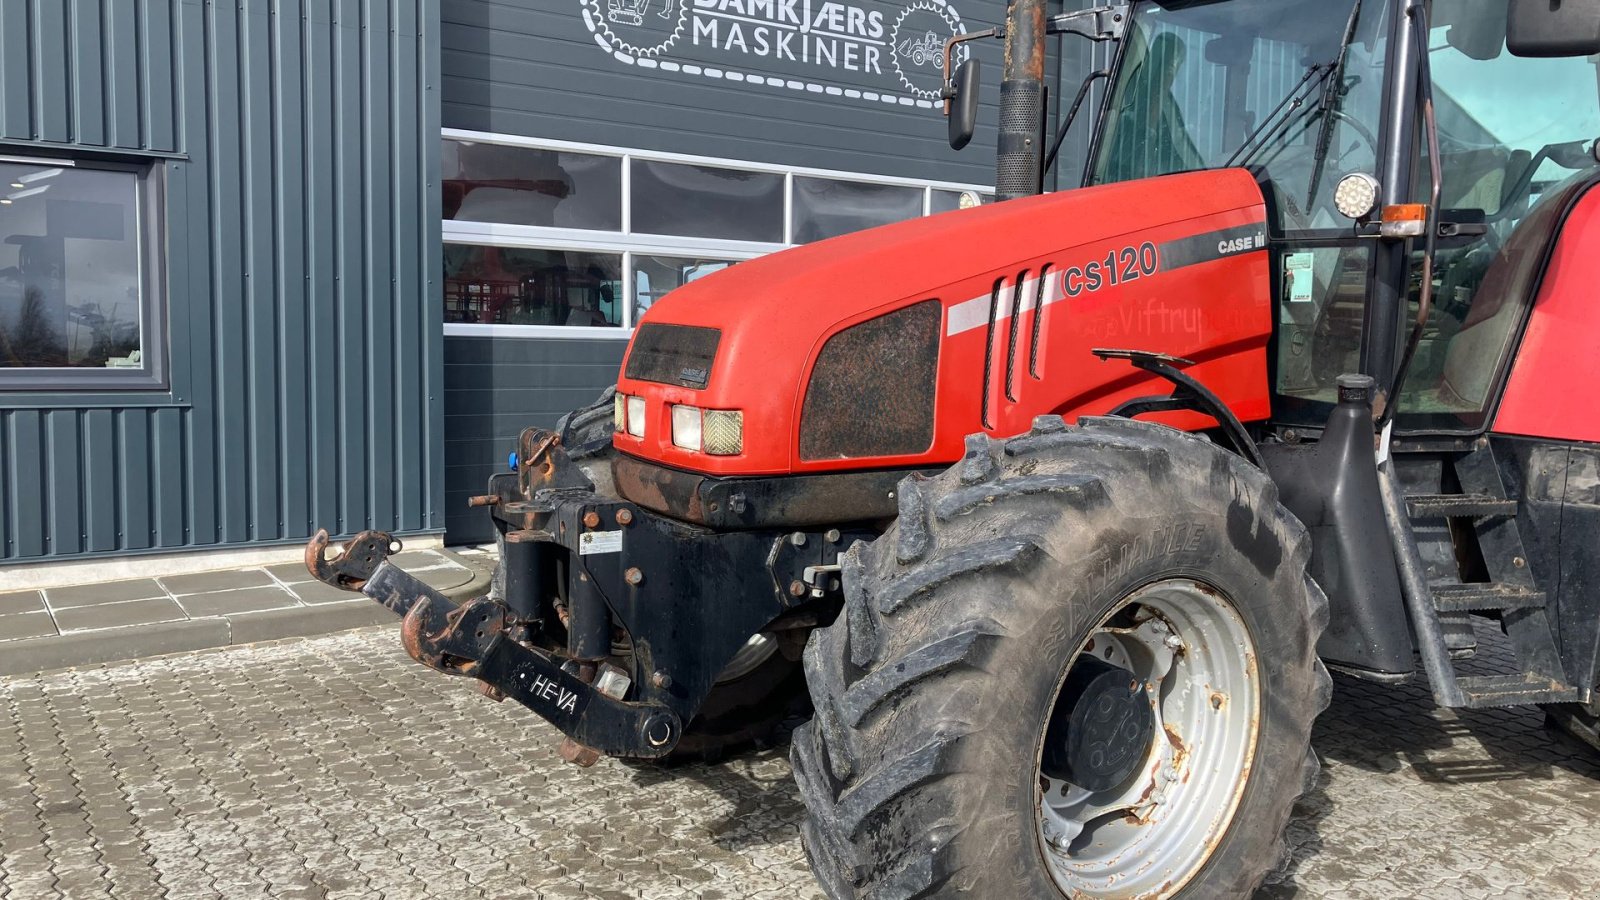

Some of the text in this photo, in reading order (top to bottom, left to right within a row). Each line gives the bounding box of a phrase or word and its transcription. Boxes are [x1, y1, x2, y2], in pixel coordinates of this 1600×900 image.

[694, 0, 884, 38] AMKJÆRS
[693, 15, 882, 75] MASKINER
[1217, 236, 1253, 254] CASE
[1063, 240, 1158, 297] CS120
[529, 673, 578, 715] HE-VA
